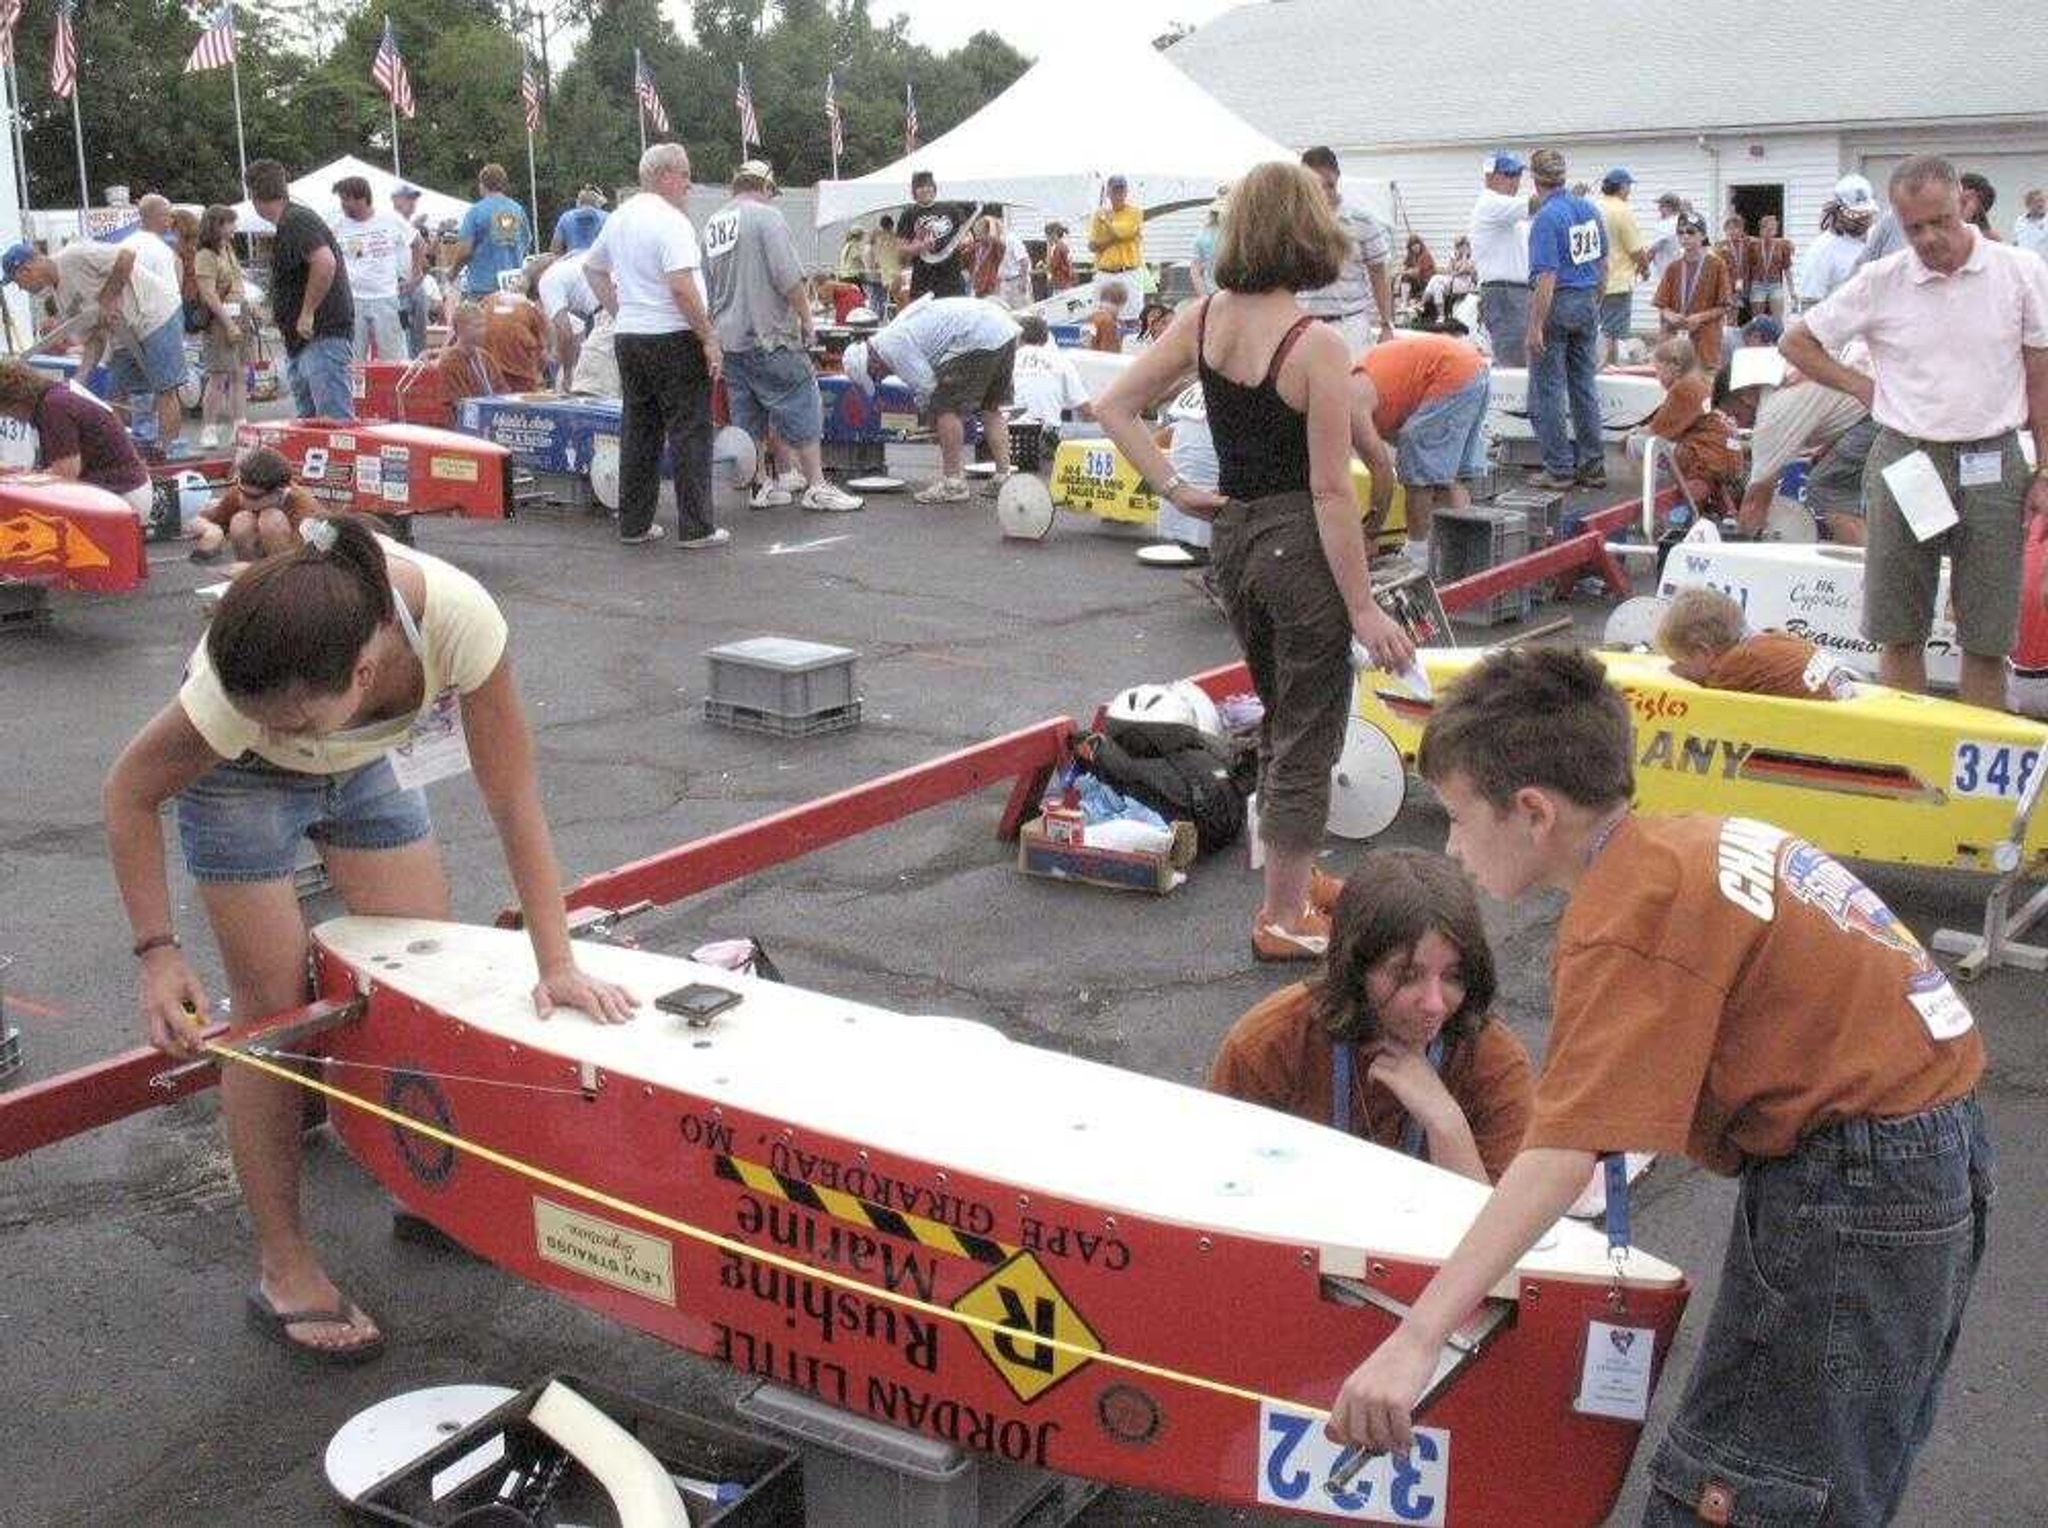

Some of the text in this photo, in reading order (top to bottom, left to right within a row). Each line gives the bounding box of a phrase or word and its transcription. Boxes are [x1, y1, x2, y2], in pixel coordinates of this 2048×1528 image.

[708, 216, 738, 249] 382
[1085, 451, 1115, 477] 368
[1785, 617, 1884, 654] Beaumo
[1632, 728, 1753, 780] ANY
[1955, 743, 2039, 797] 348
[679, 1113, 1131, 1272] CAPE GIRARDEAU, MO
[547, 1236, 664, 1287] LEVI STRAUSS
[735, 1194, 938, 1302] Marine
[719, 1233, 939, 1375] Rushing
[993, 1284, 1057, 1375] R
[712, 1319, 848, 1405] LITTLE
[866, 1376, 1064, 1467] JORDAN
